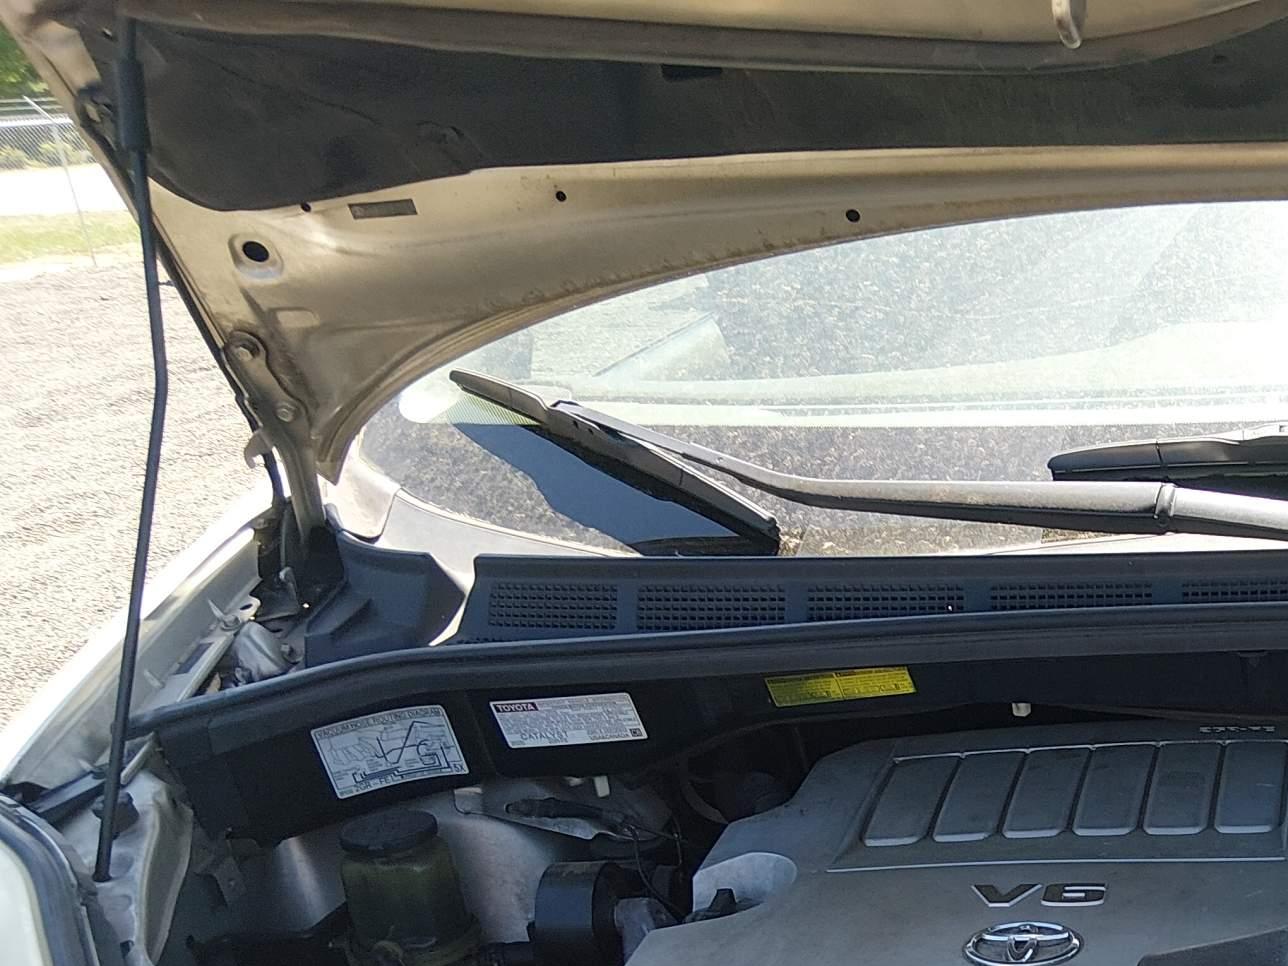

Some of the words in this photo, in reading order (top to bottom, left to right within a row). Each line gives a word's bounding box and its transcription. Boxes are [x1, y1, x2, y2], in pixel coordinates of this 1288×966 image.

[496, 702, 535, 713] TOYOTA
[520, 730, 568, 741] CATALYST
[971, 882, 1107, 907] V6
